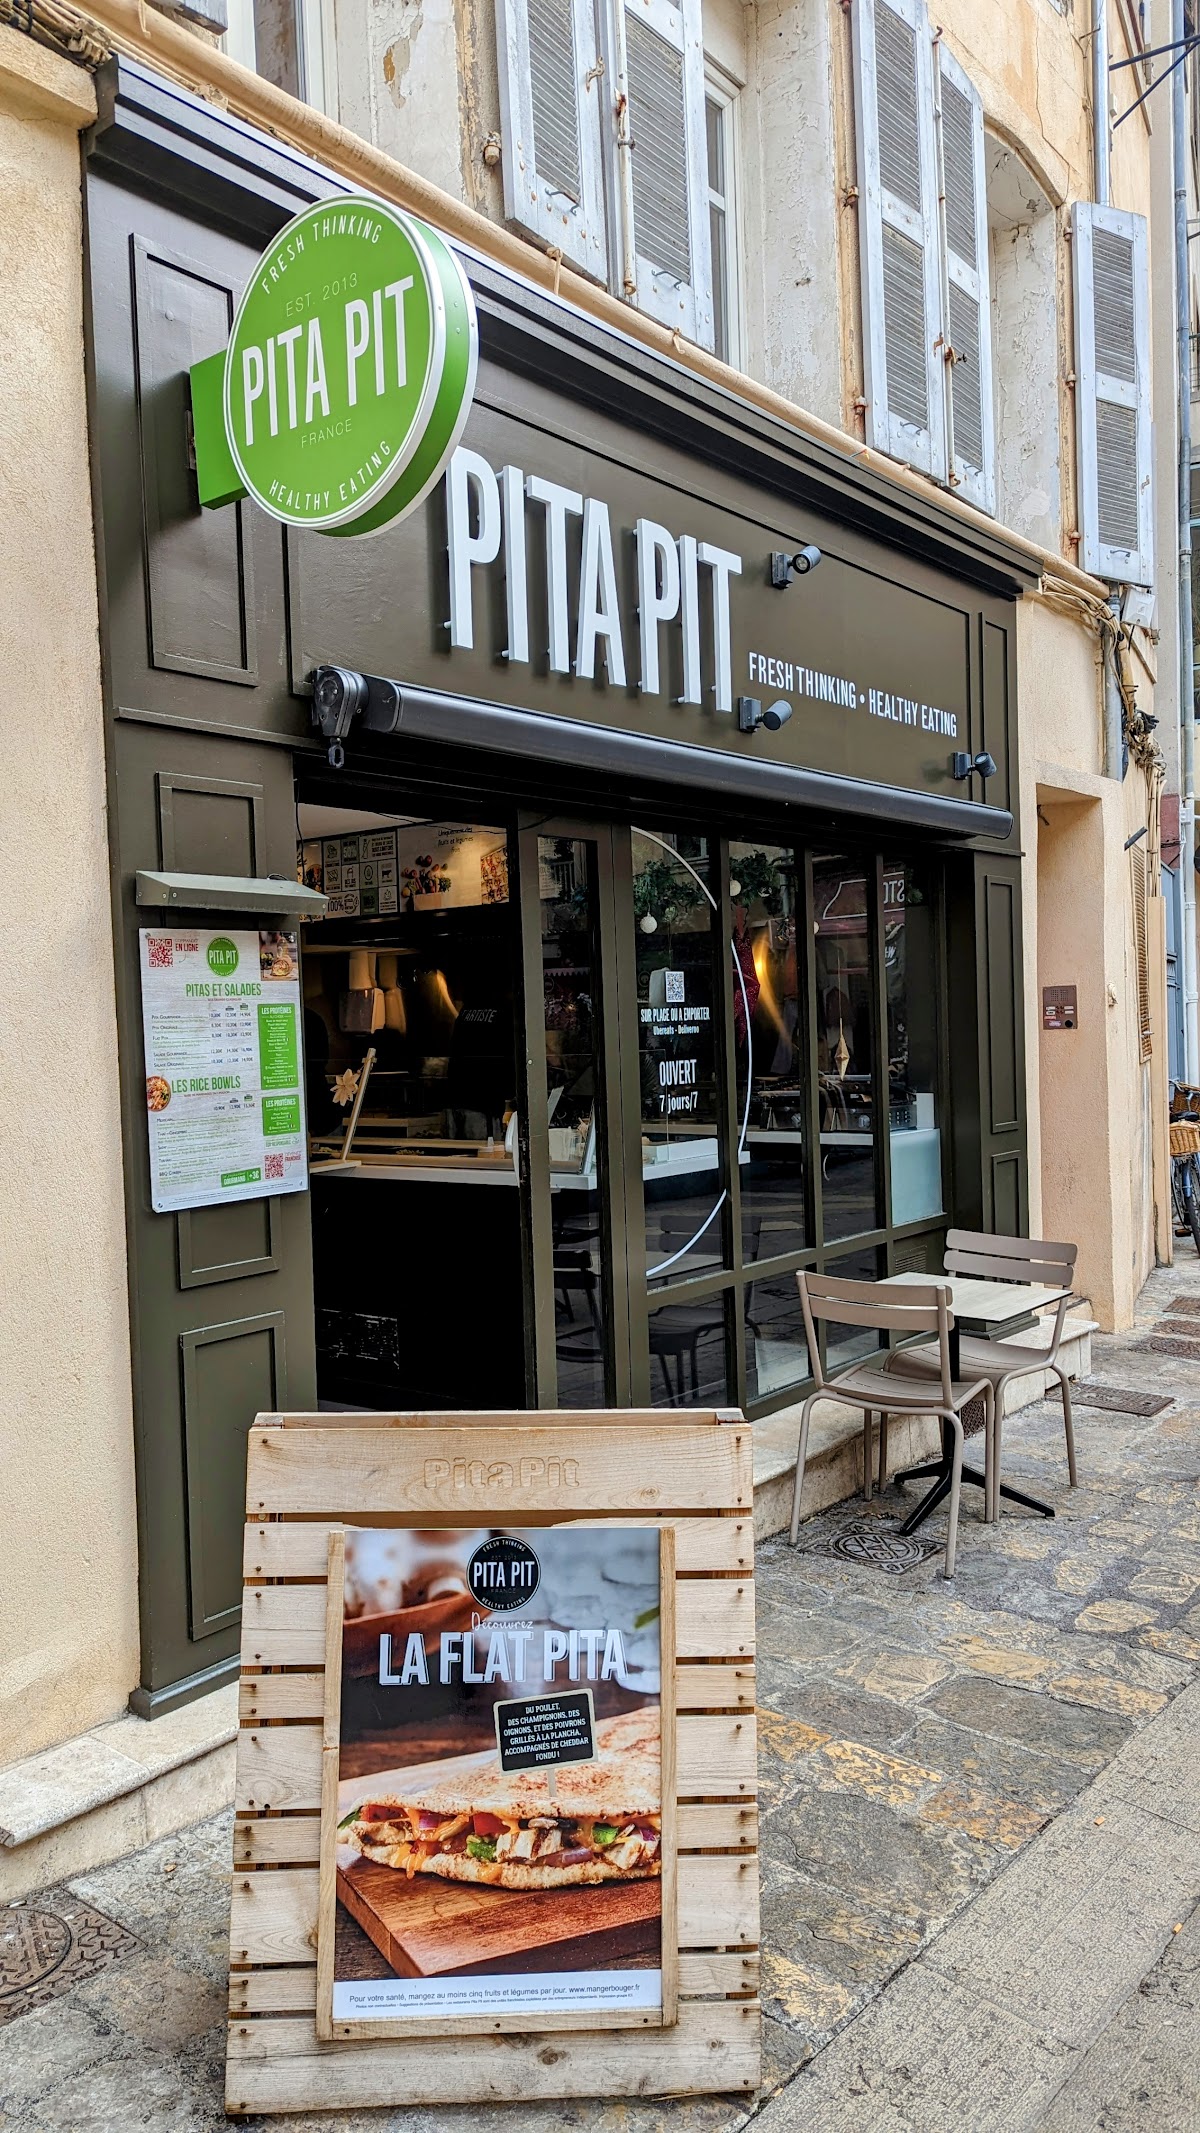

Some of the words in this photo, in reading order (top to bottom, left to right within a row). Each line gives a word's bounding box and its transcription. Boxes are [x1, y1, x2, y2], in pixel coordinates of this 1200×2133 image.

[261, 233, 305, 294] FRESH
[312, 214, 382, 244] THINKING
[286, 293, 316, 317] EST.
[323, 273, 358, 301] 2013
[242, 317, 331, 446] PITA
[345, 275, 414, 407] PIT
[301, 418, 353, 449] FRANCE
[269, 479, 330, 511] HEALTHY
[340, 440, 391, 501] EATING
[446, 446, 627, 687] PITA
[636, 518, 742, 713] PIT
[749, 652, 794, 692] FRESH
[796, 666, 857, 710] THINKING
[868, 688, 919, 726] HEALTHY
[921, 705, 957, 738] EATING
[175, 943, 183, 952] EN
[184, 943, 199, 951] LIGNE
[209, 950, 224, 964] PITA
[226, 950, 236, 964] PIT
[186, 984, 210, 997] PITAS
[212, 984, 224, 996] ET
[225, 983, 261, 996] SALADES
[641, 1008, 652, 1022] SUR
[653, 1008, 669, 1022] PLACE
[670, 1008, 678, 1021] OU
[684, 1007, 710, 1021] EMPORTER
[659, 1059, 697, 1086] OUVERT
[172, 1080, 188, 1093] LES
[190, 1078, 210, 1092] RICE
[212, 1076, 241, 1090] BOWLS
[660, 1095, 666, 1112] 7
[668, 1092, 698, 1114] jours/7
[482, 1541, 500, 1552] FRESH
[502, 1540, 526, 1552] THINKING
[474, 1562, 506, 1588] PITA
[511, 1561, 535, 1587] PIT
[482, 1597, 504, 1610] HEALTHY
[506, 1596, 526, 1608] EATING
[471, 1612, 534, 1630] Découvrez
[379, 1633, 430, 1685] LA
[440, 1631, 534, 1684] FLAT
[543, 1629, 629, 1682] PITA
[542, 1723, 554, 1731] DES
[555, 1718, 586, 1729] POIVRONS
[505, 1742, 550, 1756] ACCOMPAGNÉS
[560, 1737, 589, 1748] CHEDDAR
[510, 1734, 536, 1745] GRILLÉS
[536, 1733, 541, 1741] À
[536, 1751, 556, 1760] FONDU
[511, 1988, 539, 1996] légumes
[553, 1987, 567, 1995] jour.
[569, 1984, 640, 1993] www.mangerbouger.fr
